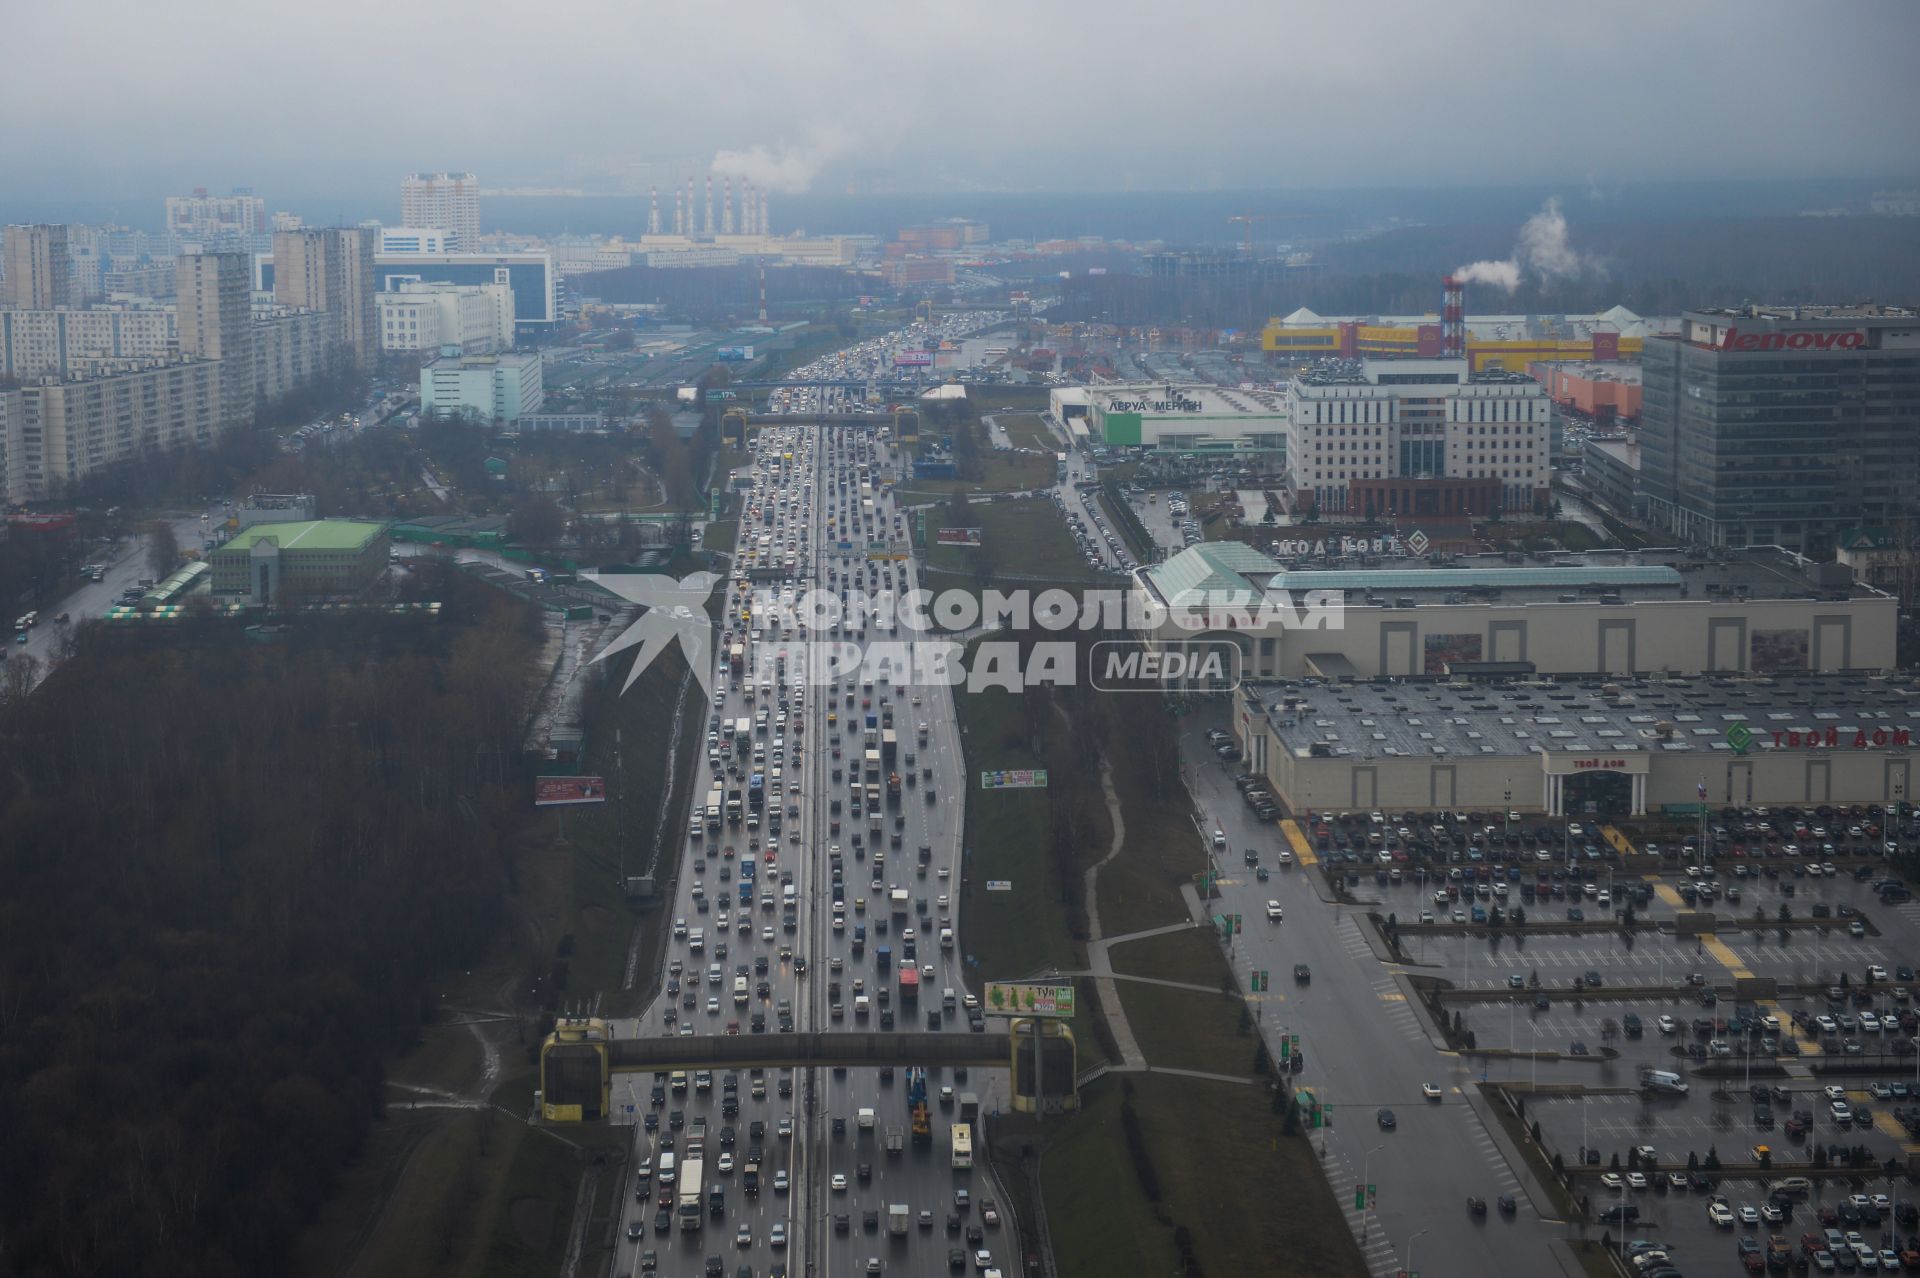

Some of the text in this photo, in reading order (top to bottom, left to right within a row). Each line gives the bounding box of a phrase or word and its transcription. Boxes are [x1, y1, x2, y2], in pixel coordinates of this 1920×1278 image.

[1723, 328, 1865, 351] lenovo
[1109, 401, 1146, 411] ЛЕРУА
[1772, 726, 1910, 748] ТВОЙ ДОМ
[1573, 759, 1626, 768] ТВОЙ ДОМ
